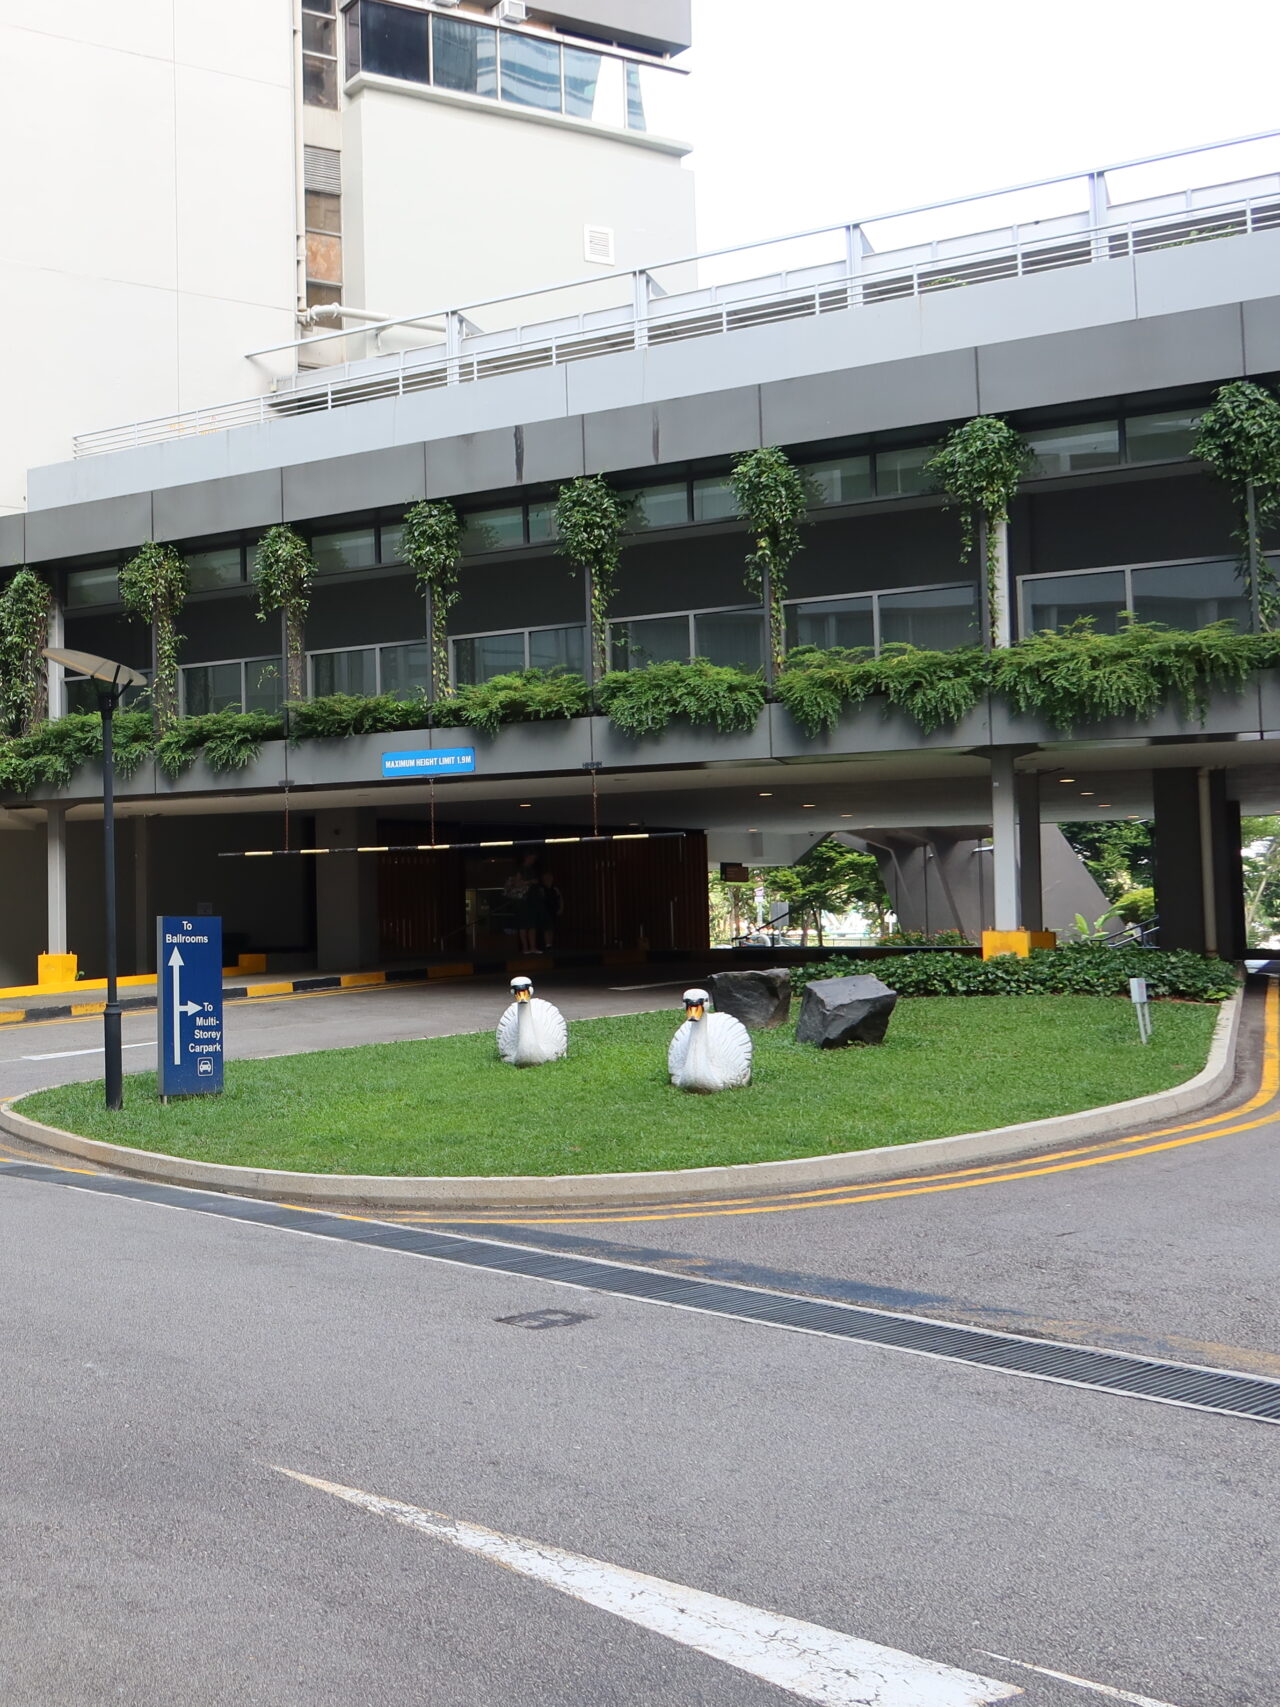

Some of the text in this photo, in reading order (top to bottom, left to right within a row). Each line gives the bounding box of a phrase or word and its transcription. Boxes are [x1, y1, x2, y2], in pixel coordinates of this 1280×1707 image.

[385, 755, 472, 768] MAXIMUM HEIGHT LIMIT 1.9M
[182, 920, 193, 931] To
[165, 934, 209, 944] Ballrooms
[203, 1002, 213, 1012] To
[195, 1016, 220, 1026] Multi-
[194, 1030, 222, 1041] Storey
[188, 1043, 222, 1054] Carpark
